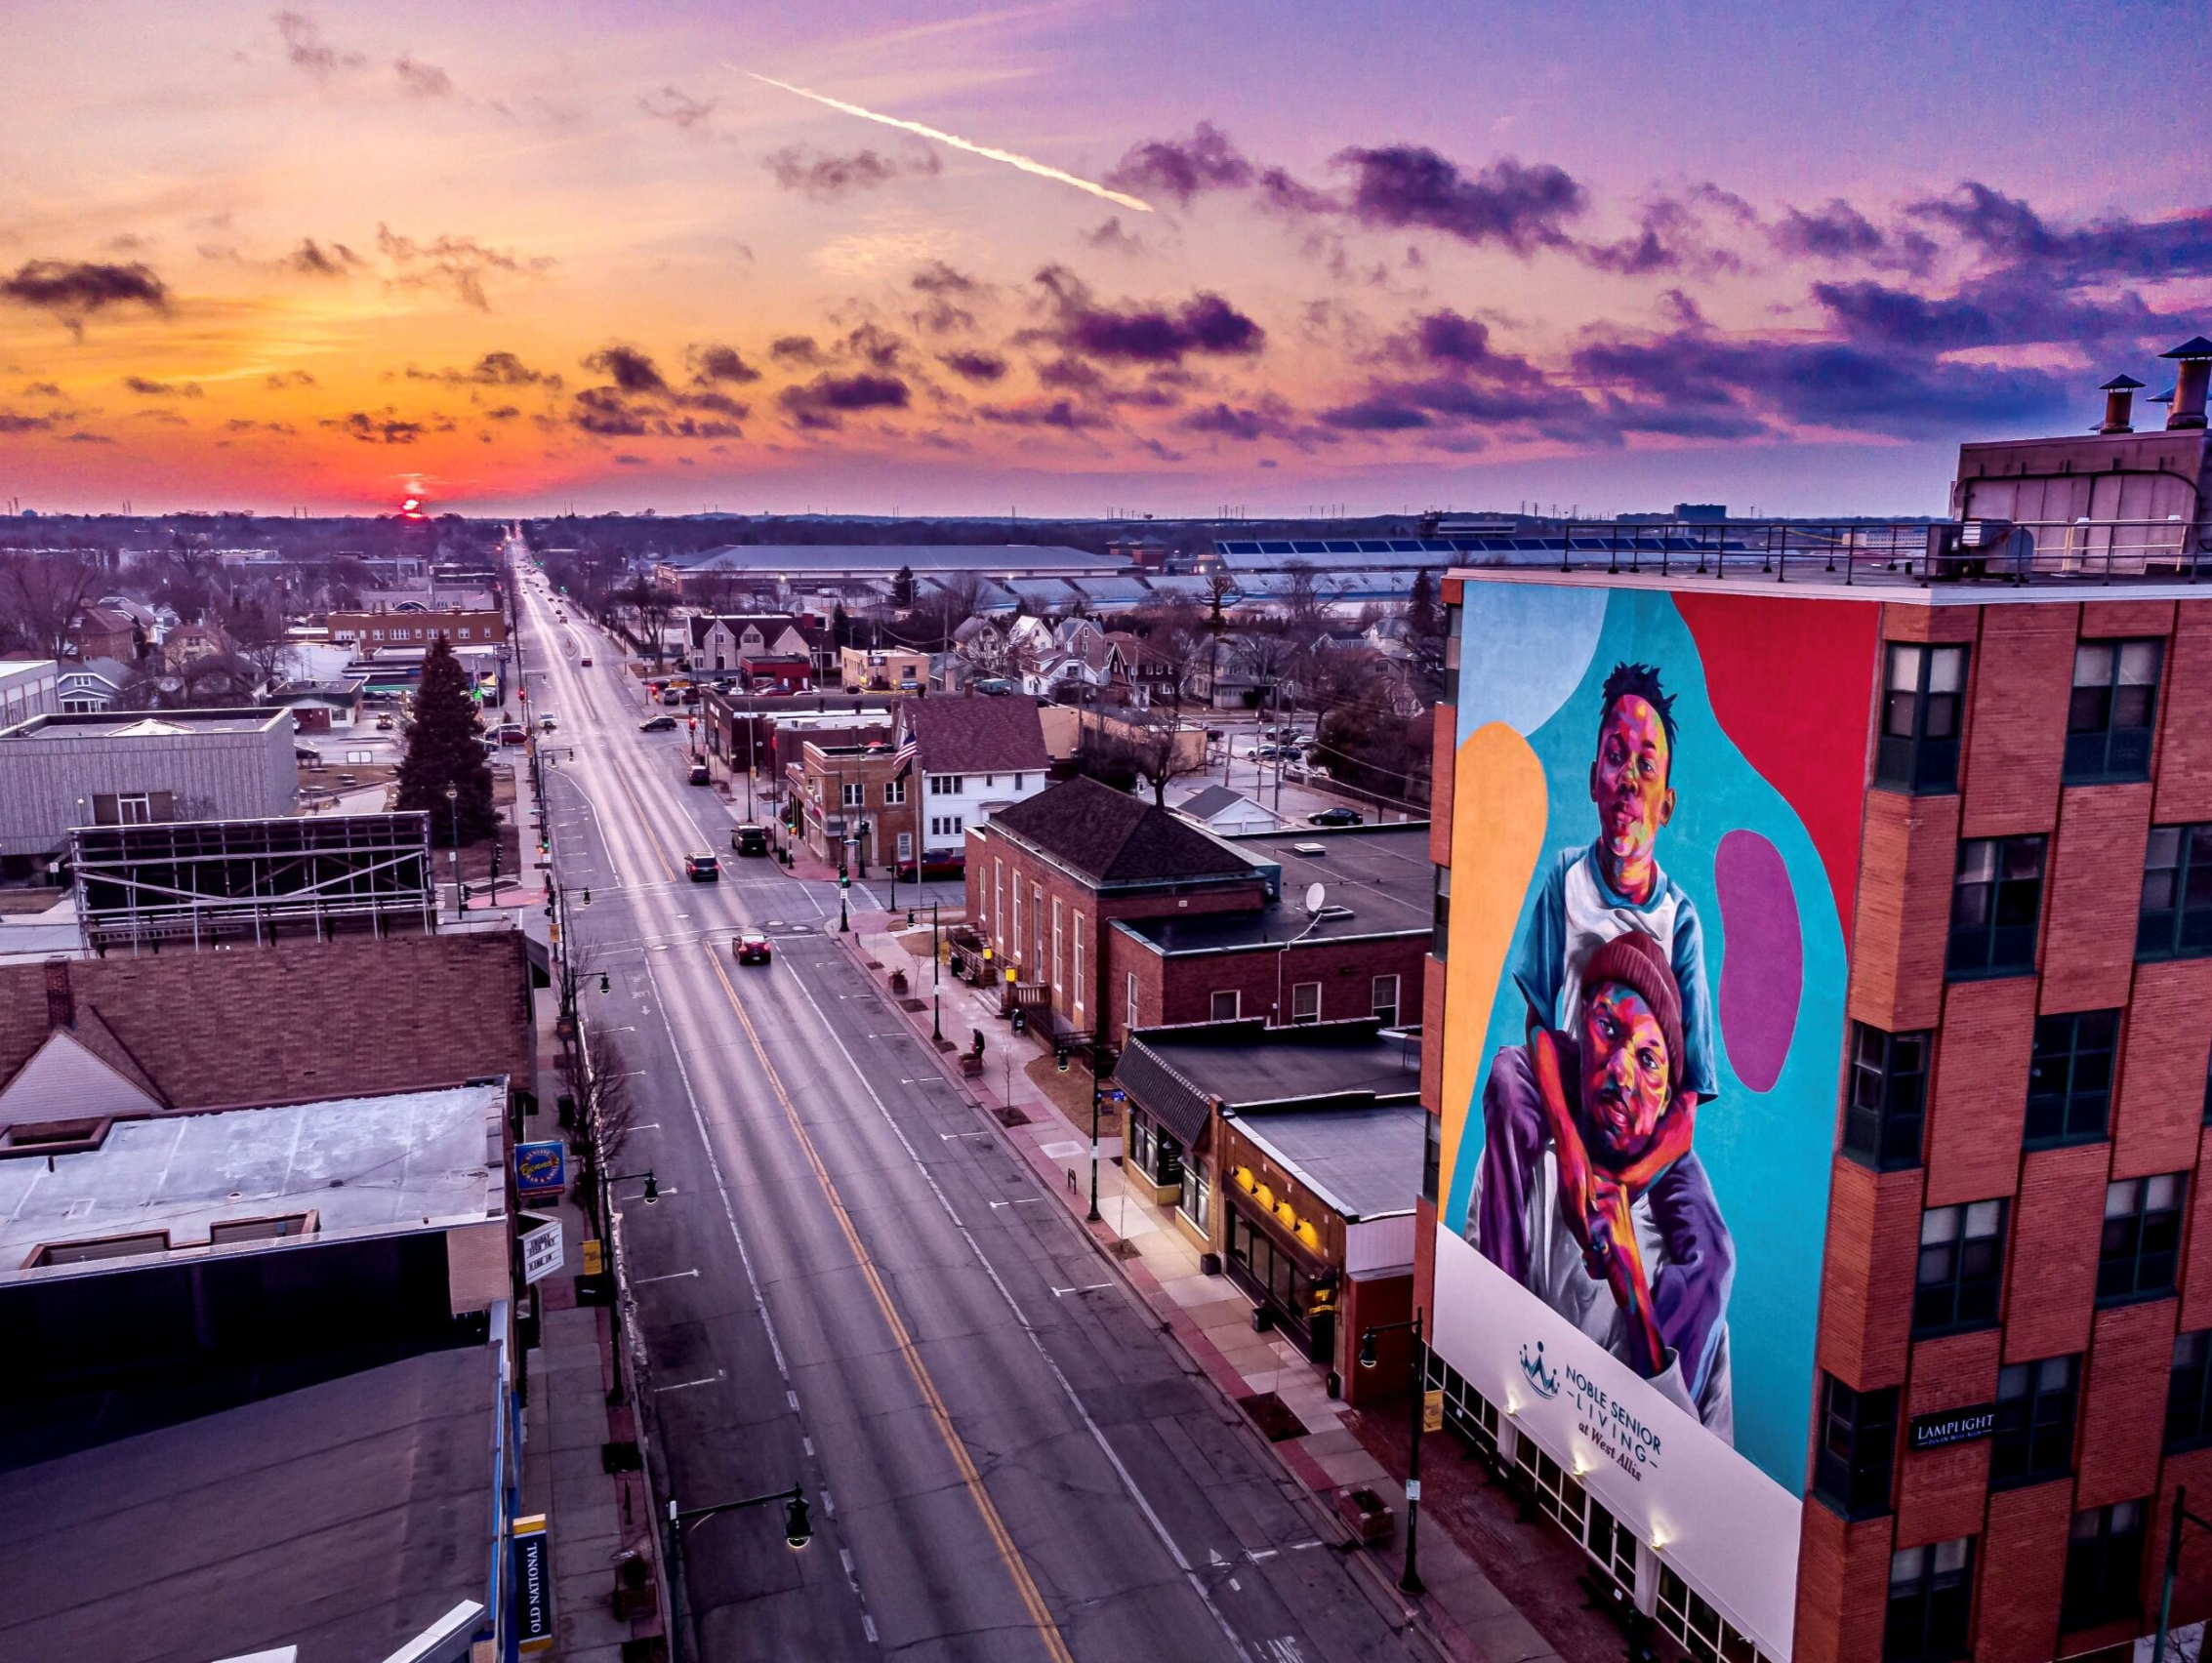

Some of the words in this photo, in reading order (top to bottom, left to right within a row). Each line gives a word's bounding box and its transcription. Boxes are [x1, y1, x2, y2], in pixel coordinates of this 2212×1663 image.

[530, 1233, 551, 1247] FRIDAY
[1566, 1364, 1607, 1409] NOBLE
[1611, 1401, 1661, 1455] SENIOR
[1577, 1393, 1647, 1463] LIVING
[1918, 1413, 1995, 1440] LAMPLIGHT
[1578, 1423, 1589, 1436] at
[1591, 1427, 1616, 1459] West
[1617, 1453, 1642, 1481] Allis
[527, 1542, 541, 1605] NATIONAL
[530, 1606, 542, 1634] OLD
